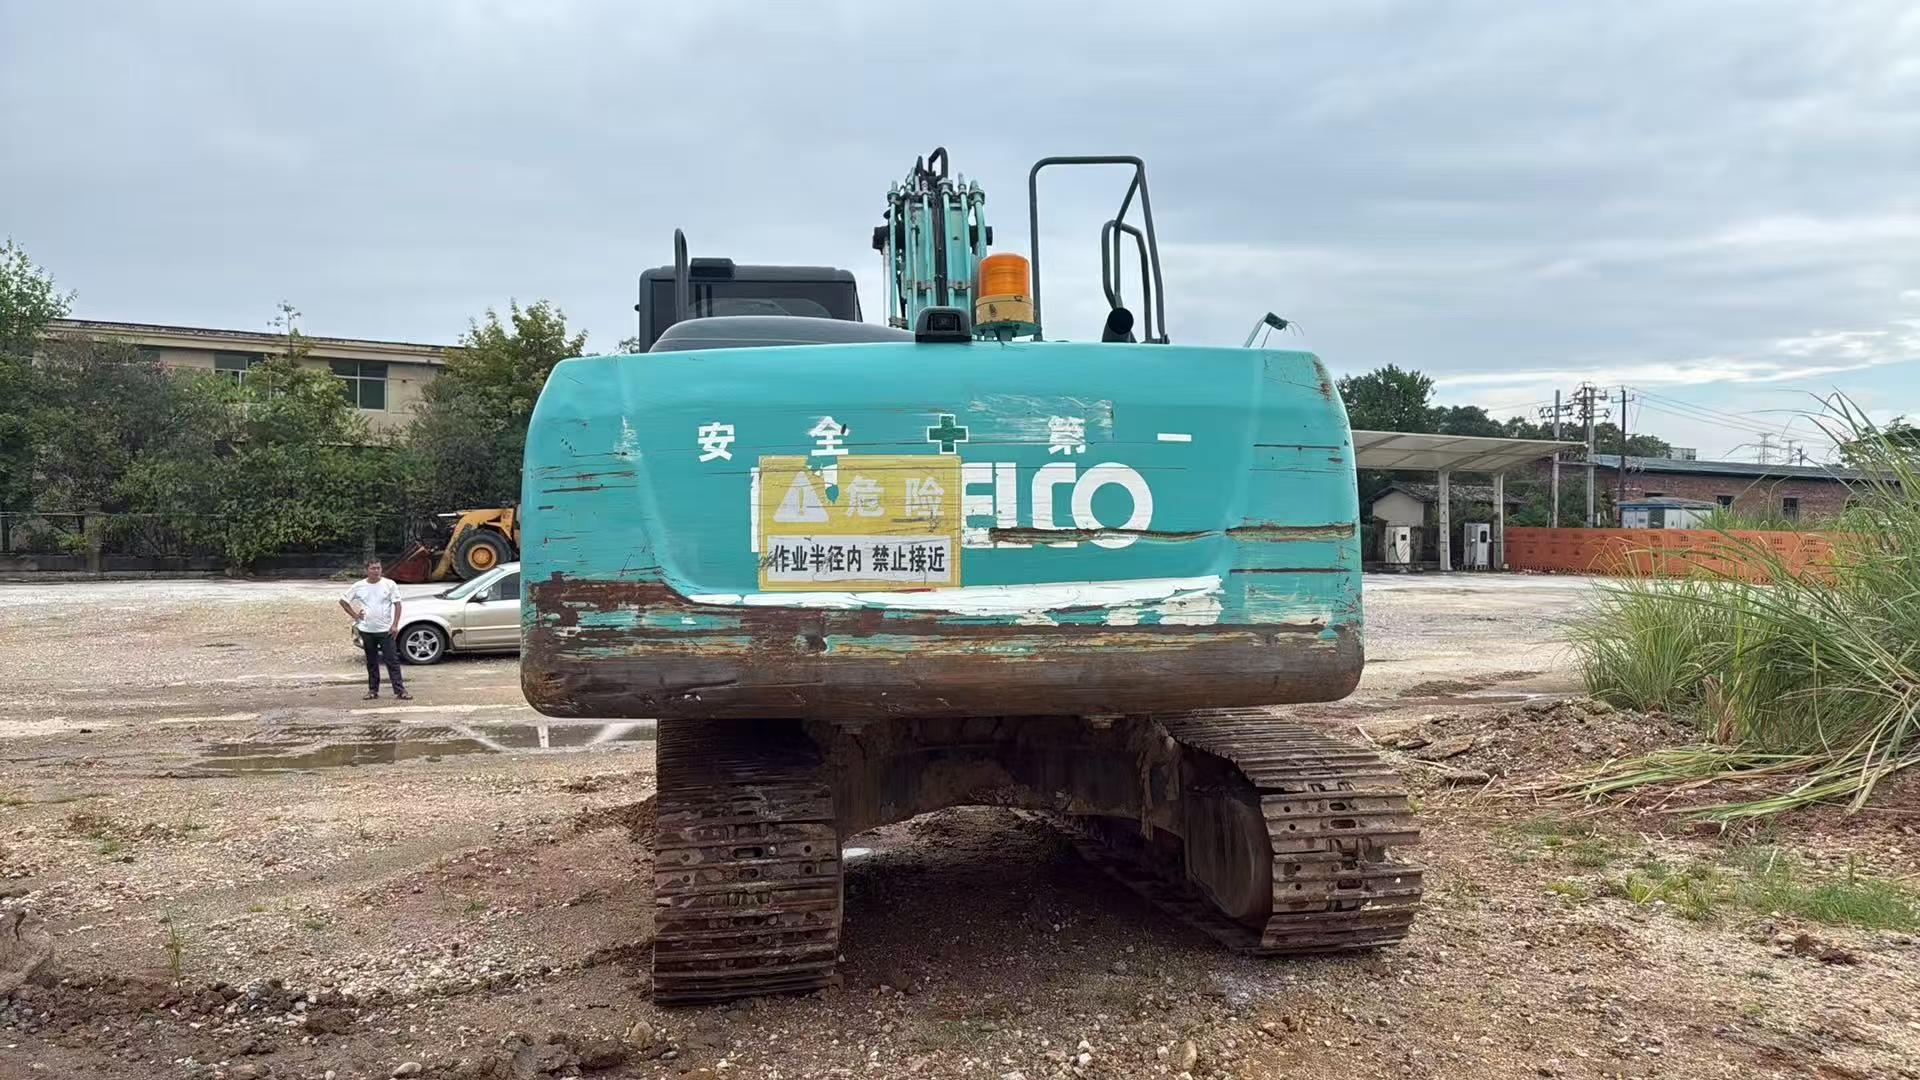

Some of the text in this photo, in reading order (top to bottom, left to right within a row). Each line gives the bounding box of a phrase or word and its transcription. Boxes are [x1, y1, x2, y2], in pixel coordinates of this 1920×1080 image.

[845, 475, 944, 517] 危险
[774, 544, 945, 573] 作业半径内 禁止接近
